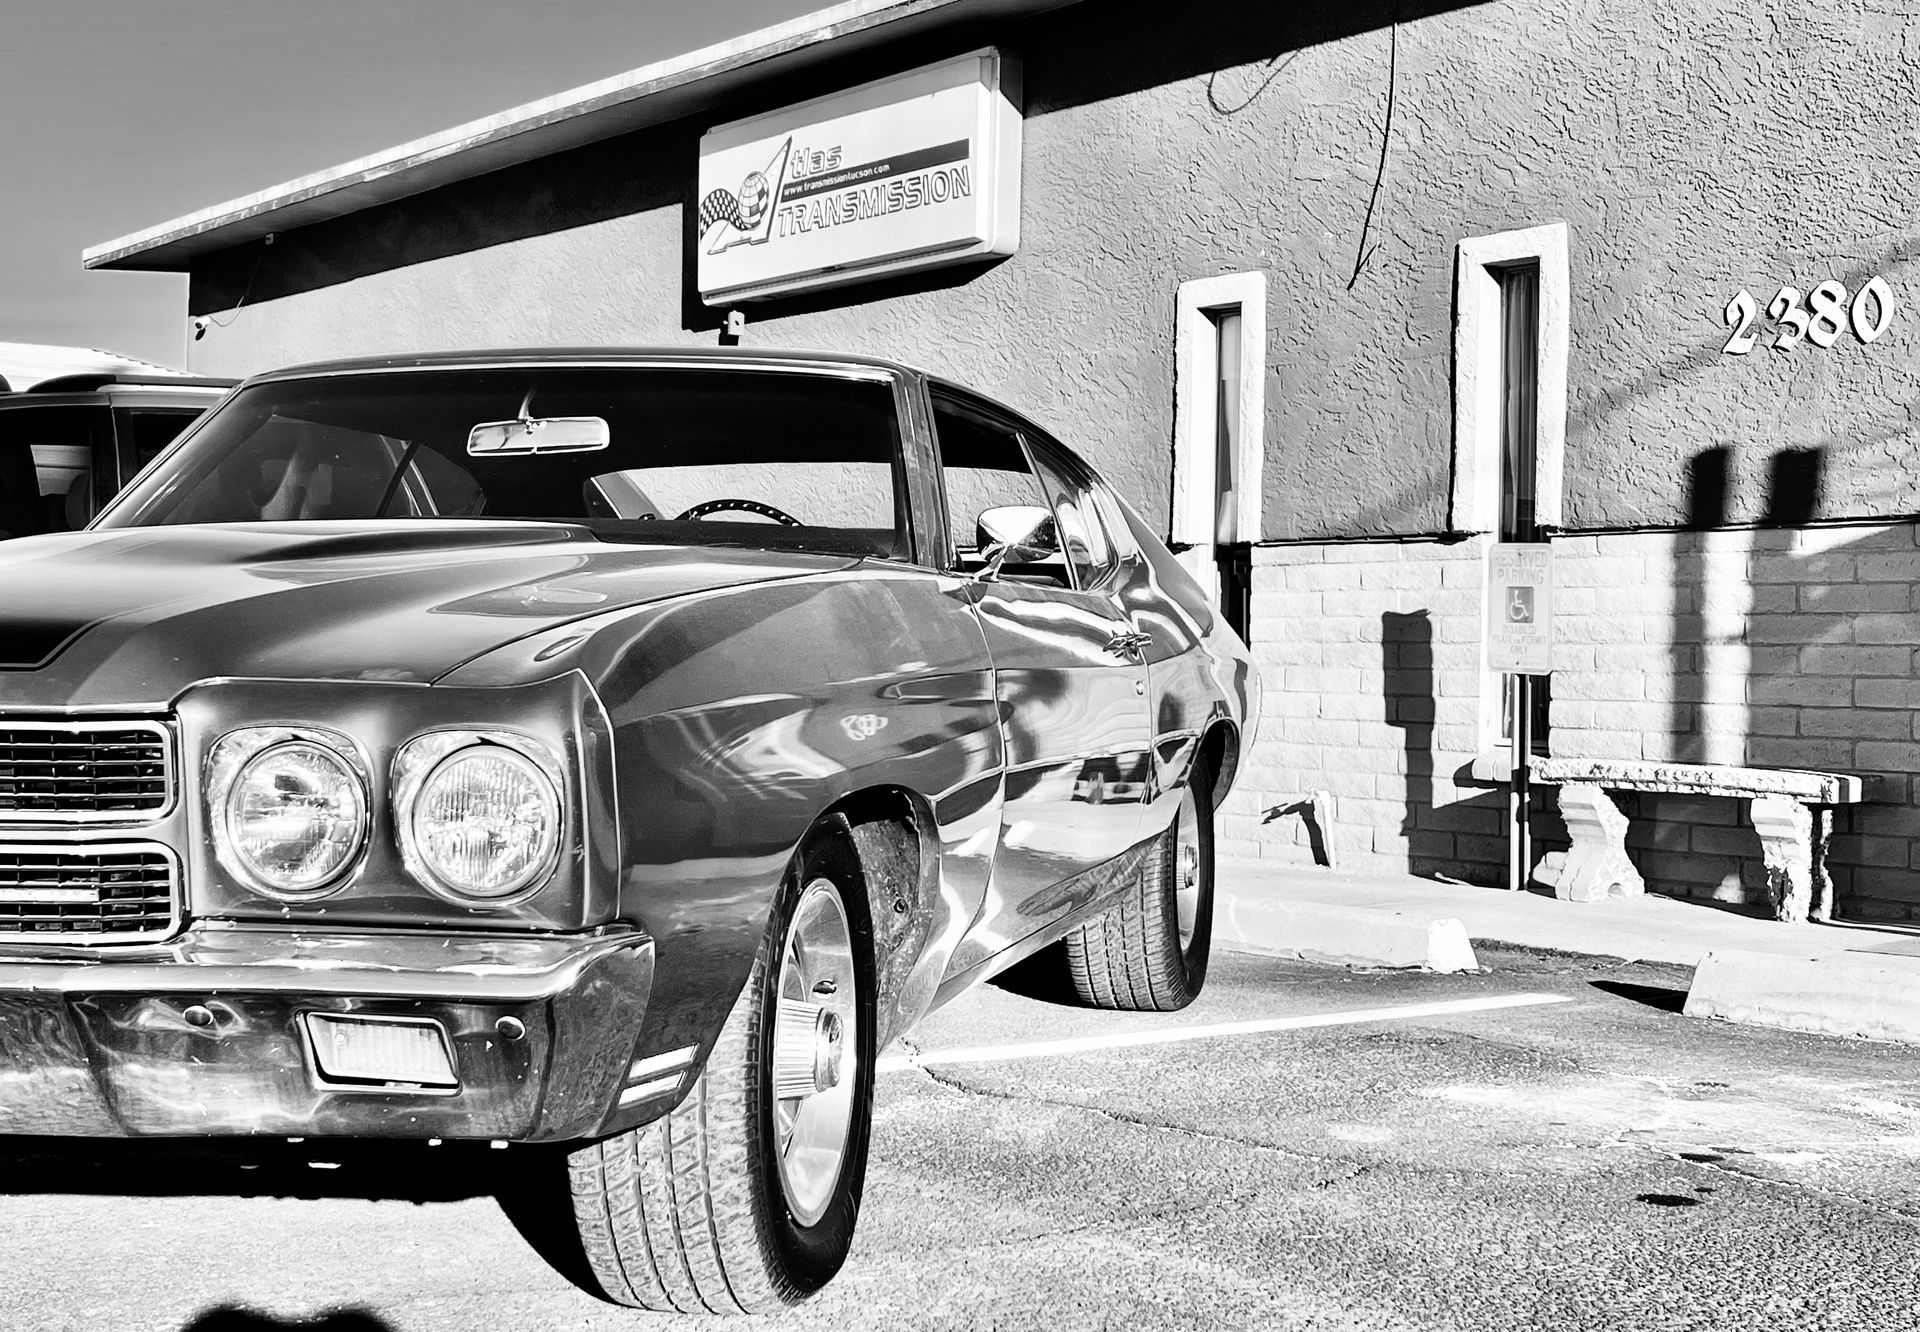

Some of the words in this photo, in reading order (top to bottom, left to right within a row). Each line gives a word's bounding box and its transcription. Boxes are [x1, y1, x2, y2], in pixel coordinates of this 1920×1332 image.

[783, 163, 890, 197] www.transmissiontucson.com
[777, 165, 971, 238] TRANSMISSION
[1720, 275, 1895, 355] 2380
[1495, 551, 1548, 567] RESERVED
[1497, 568, 1544, 584] PARKING
